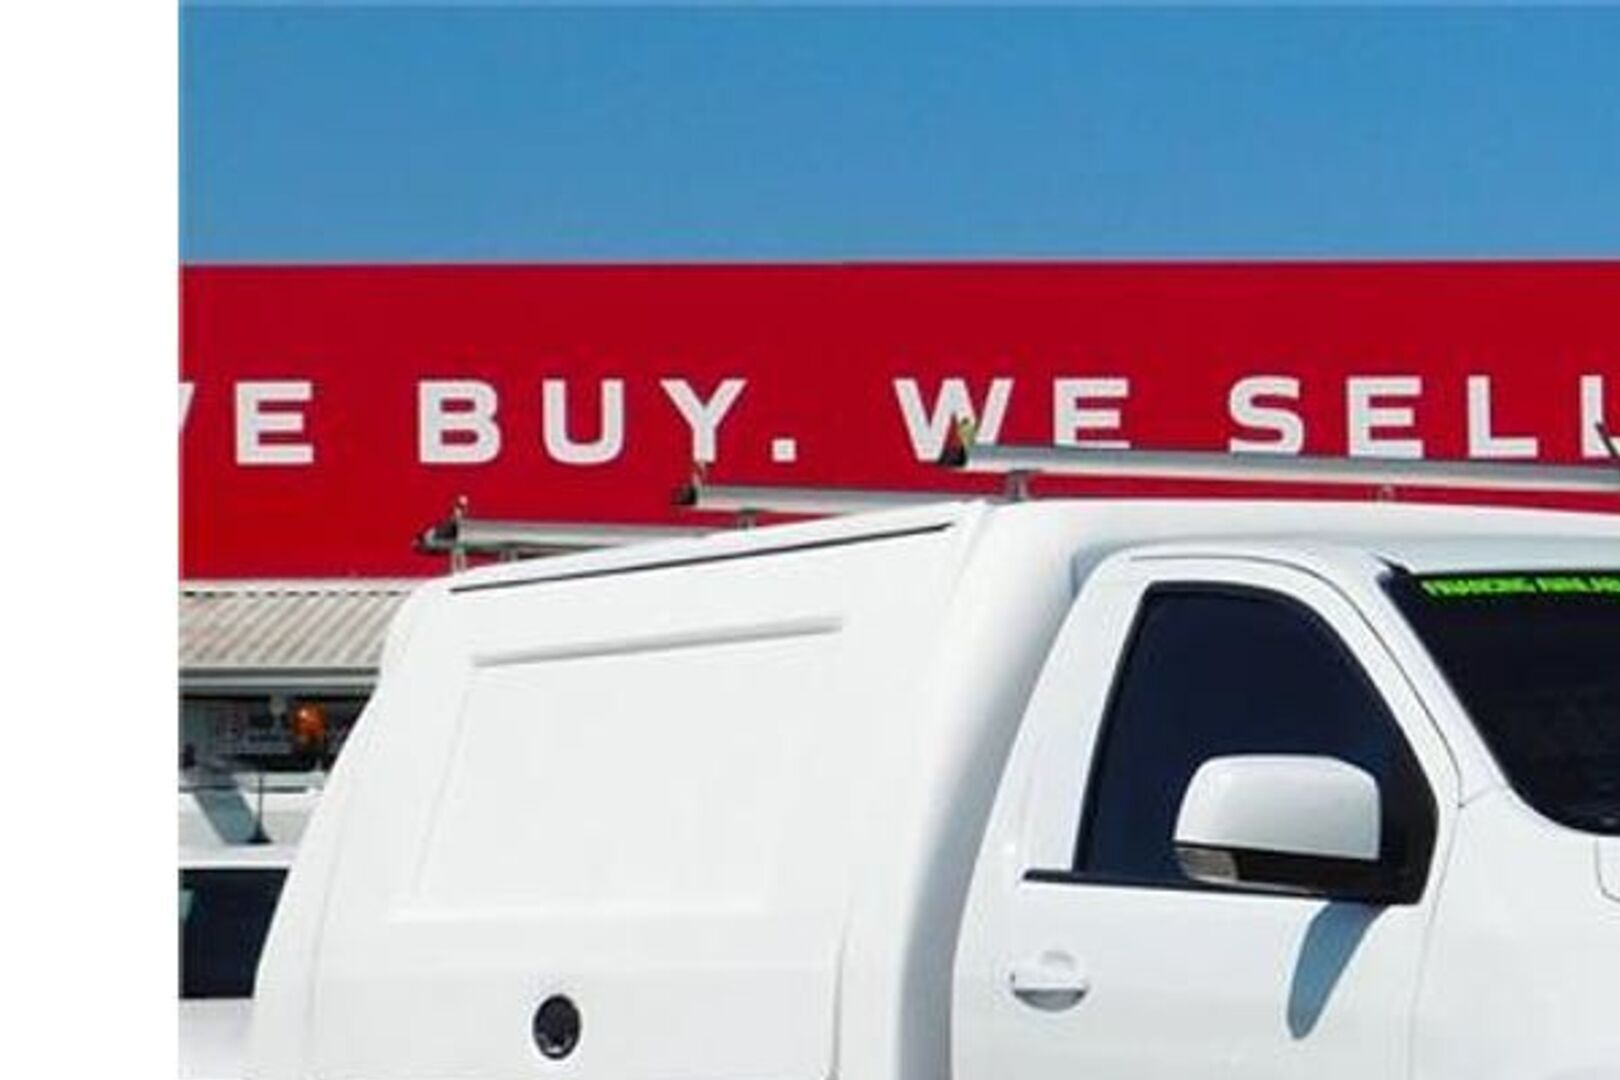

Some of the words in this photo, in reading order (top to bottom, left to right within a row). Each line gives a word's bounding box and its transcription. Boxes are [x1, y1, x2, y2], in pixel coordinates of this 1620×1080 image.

[178, 381, 314, 464] E
[419, 379, 796, 466] BUY.
[894, 377, 1130, 461] WE
